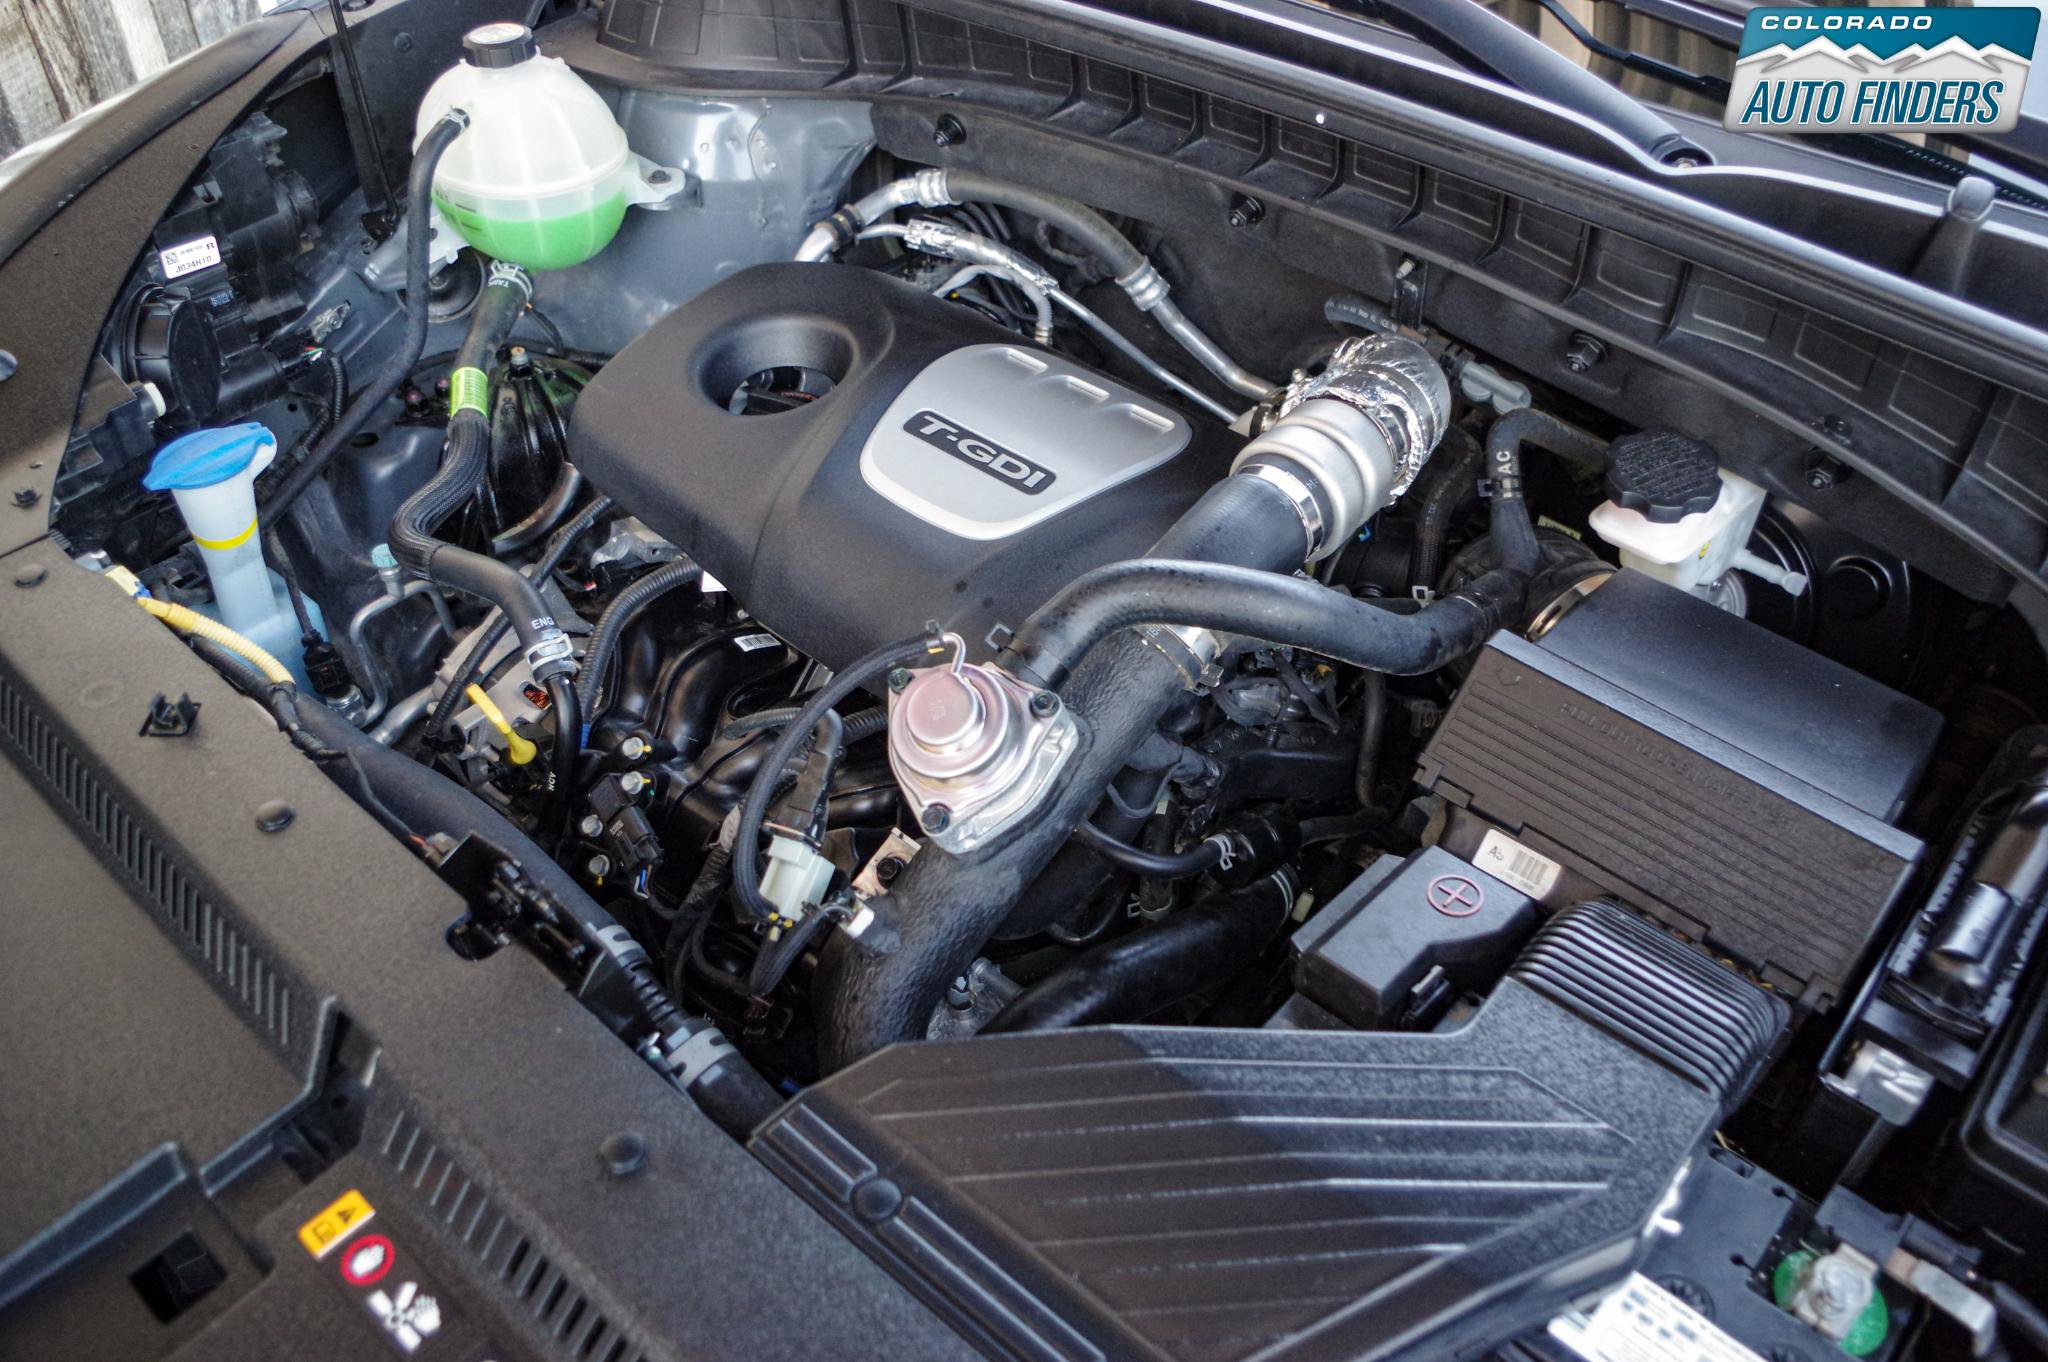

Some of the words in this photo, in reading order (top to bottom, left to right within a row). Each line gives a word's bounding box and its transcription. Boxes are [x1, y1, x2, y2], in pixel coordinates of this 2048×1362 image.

[919, 415, 1046, 488] T-GDI
[1496, 451, 1512, 475] AC
[531, 616, 555, 630] ENG
